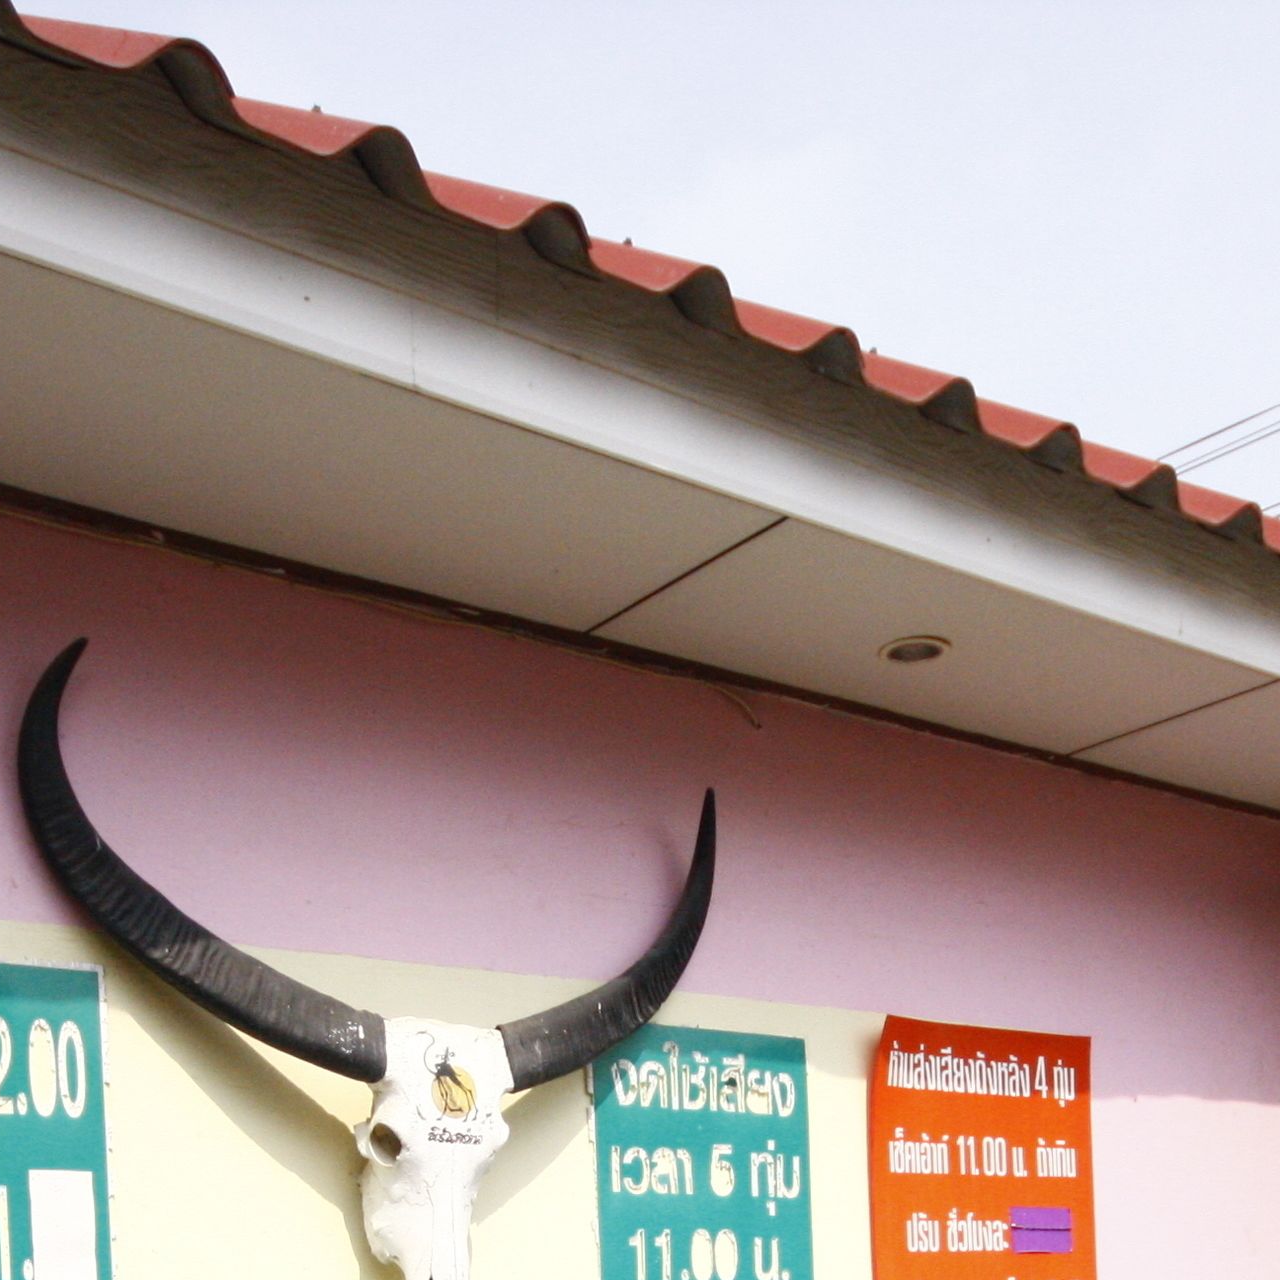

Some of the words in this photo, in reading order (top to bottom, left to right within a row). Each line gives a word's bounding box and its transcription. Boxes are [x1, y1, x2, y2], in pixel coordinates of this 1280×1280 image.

[612, 1042, 796, 1118] งดใช้เสียง
[1035, 1056, 1048, 1098] 4
[1054, 1060, 1075, 1107] ทุ่ม
[610, 1146, 694, 1196] เวลา
[750, 1140, 801, 1216] ทุ่ม
[957, 1136, 1007, 1176] 11.00
[1012, 1147, 1028, 1177] น.
[906, 1212, 940, 1252] ปรับ
[947, 1208, 1009, 1252] ชั่วโมงละ
